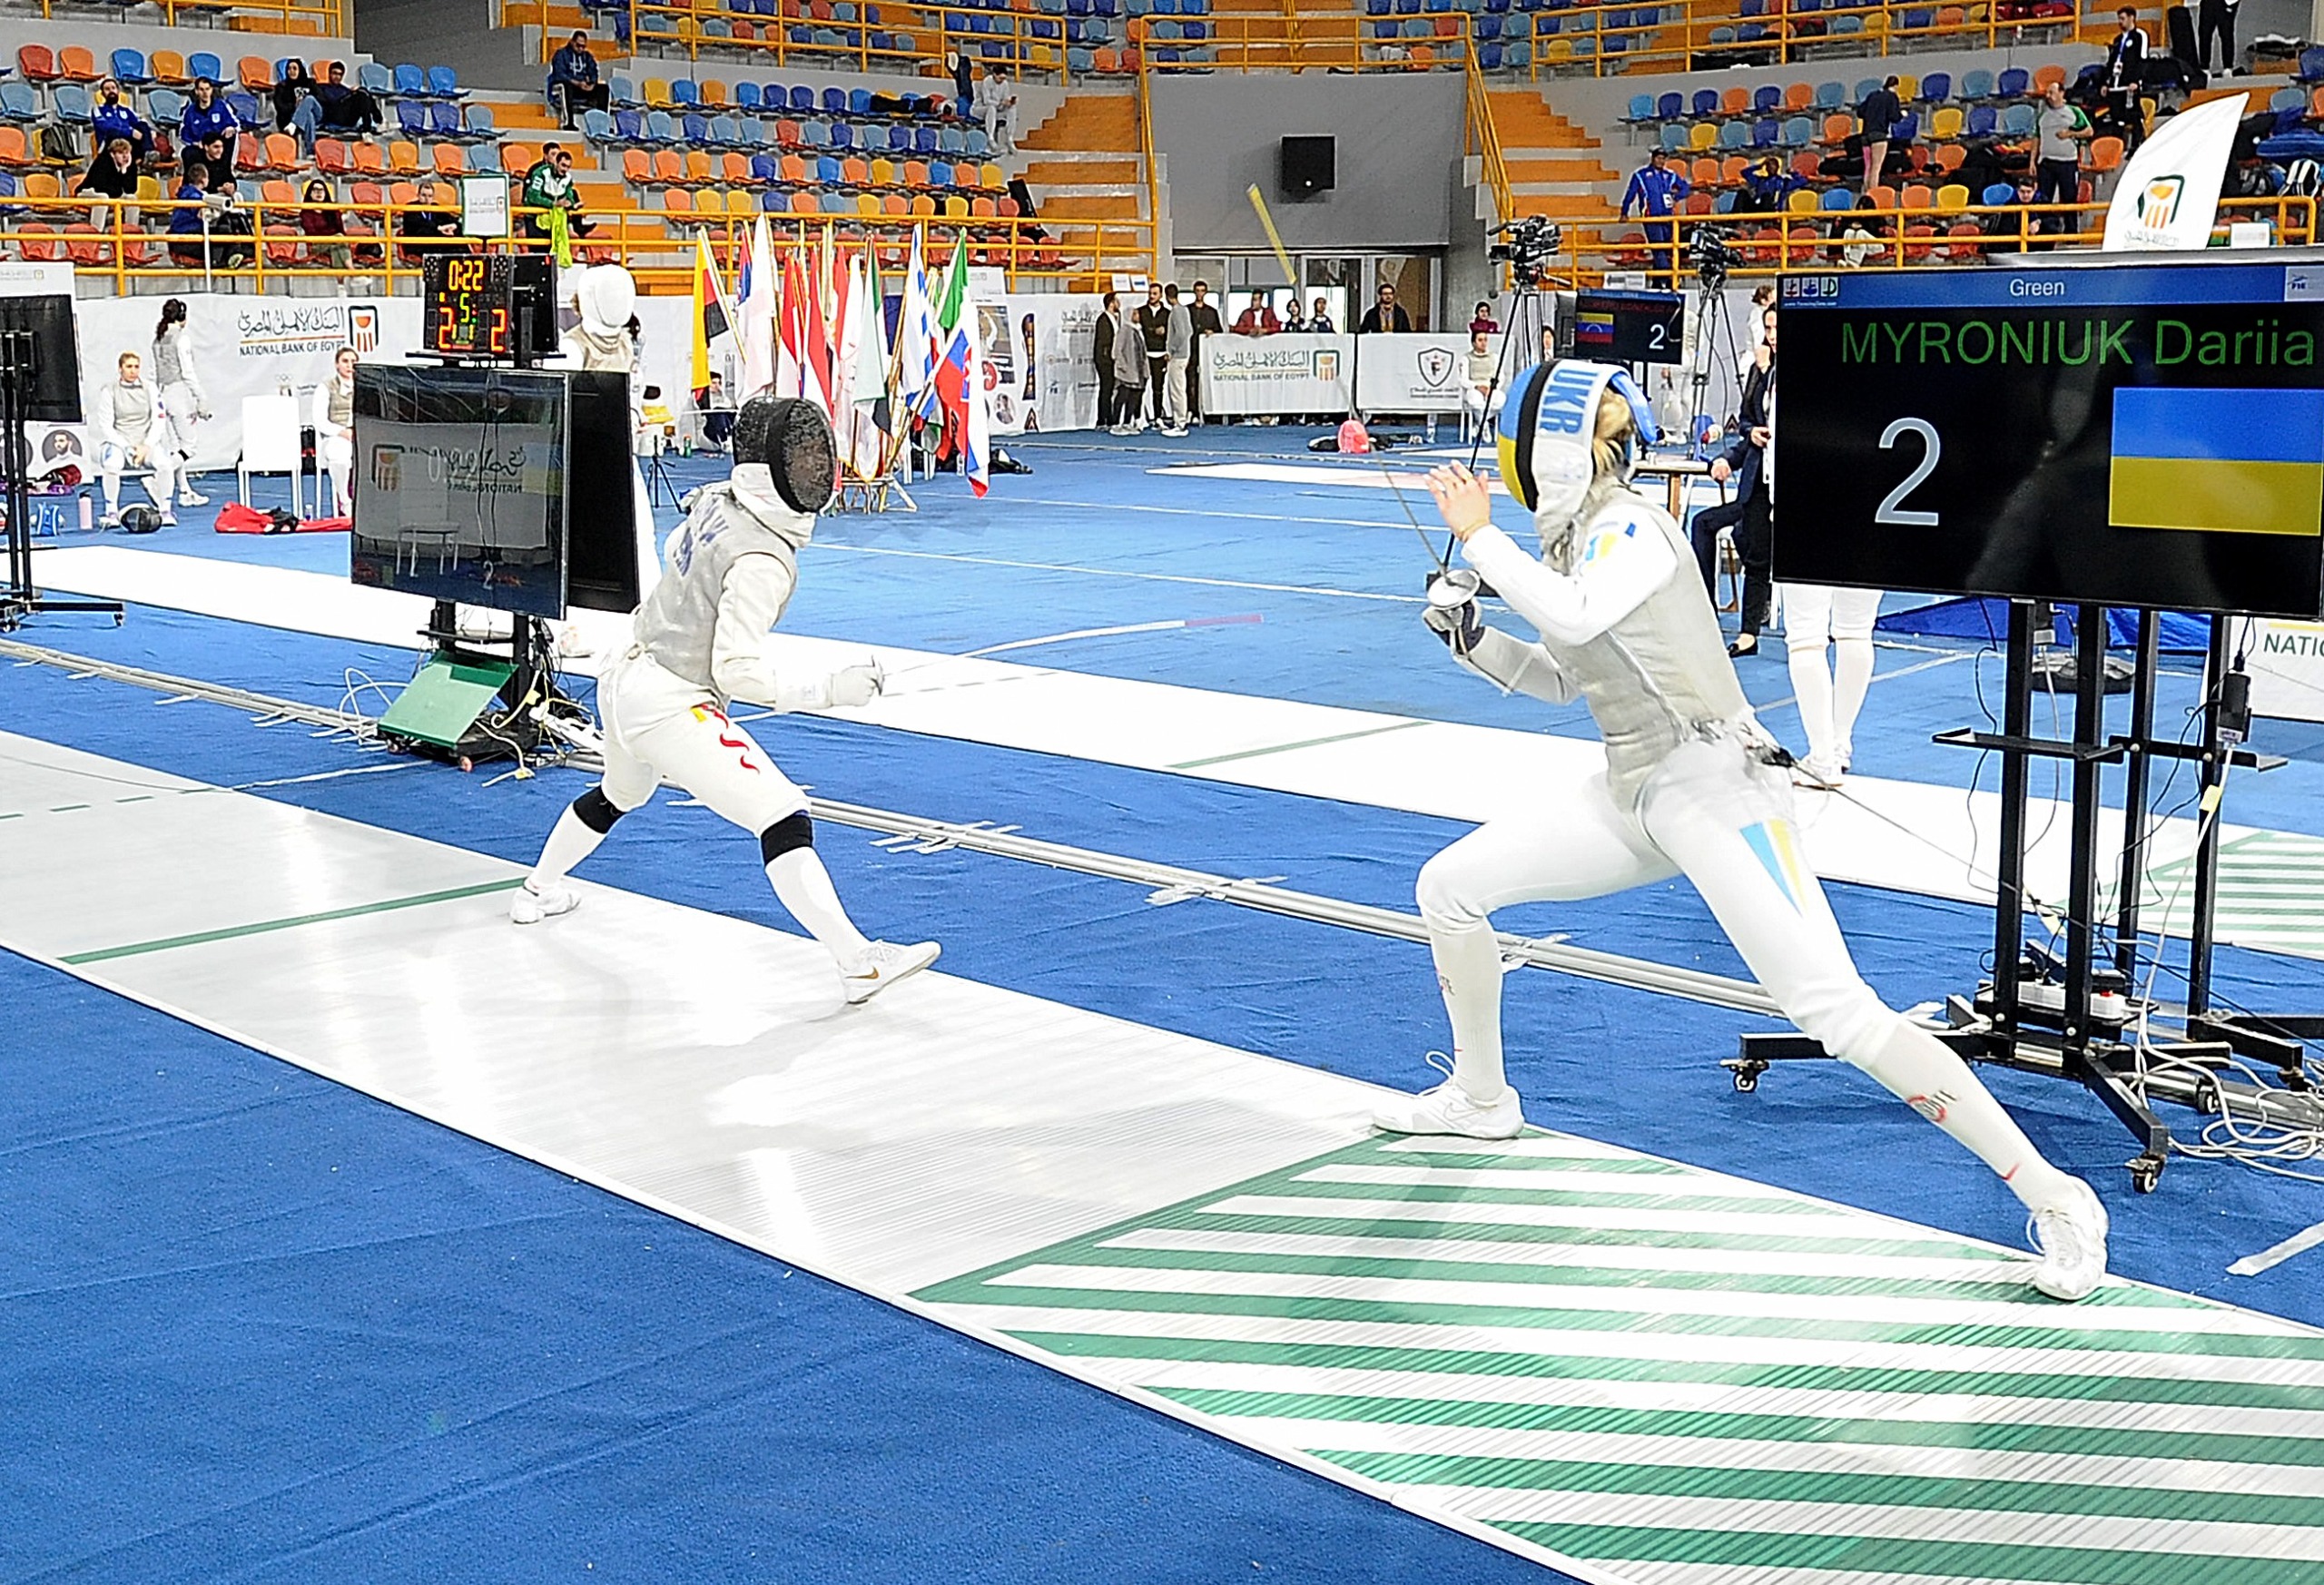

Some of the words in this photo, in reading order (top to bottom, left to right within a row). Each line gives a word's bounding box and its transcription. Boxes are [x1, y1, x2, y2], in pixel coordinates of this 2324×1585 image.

[448, 260, 484, 291] 0:22
[2009, 278, 2065, 297] Green
[459, 292, 470, 323] 5
[438, 307, 453, 349] 2
[491, 309, 507, 351] 2
[1649, 323, 1665, 349] 2
[1842, 320, 2133, 365] MYRONIUK
[2156, 320, 2314, 365] Dariia
[240, 344, 281, 356] NATIONAL
[281, 343, 305, 353] BANK
[307, 341, 318, 352] OF
[1252, 373, 1272, 381] BANK
[1285, 372, 1309, 380] EGYPT
[1539, 369, 1600, 435] UKR
[1875, 417, 1941, 527] 2
[2263, 633, 2324, 657] NATI
